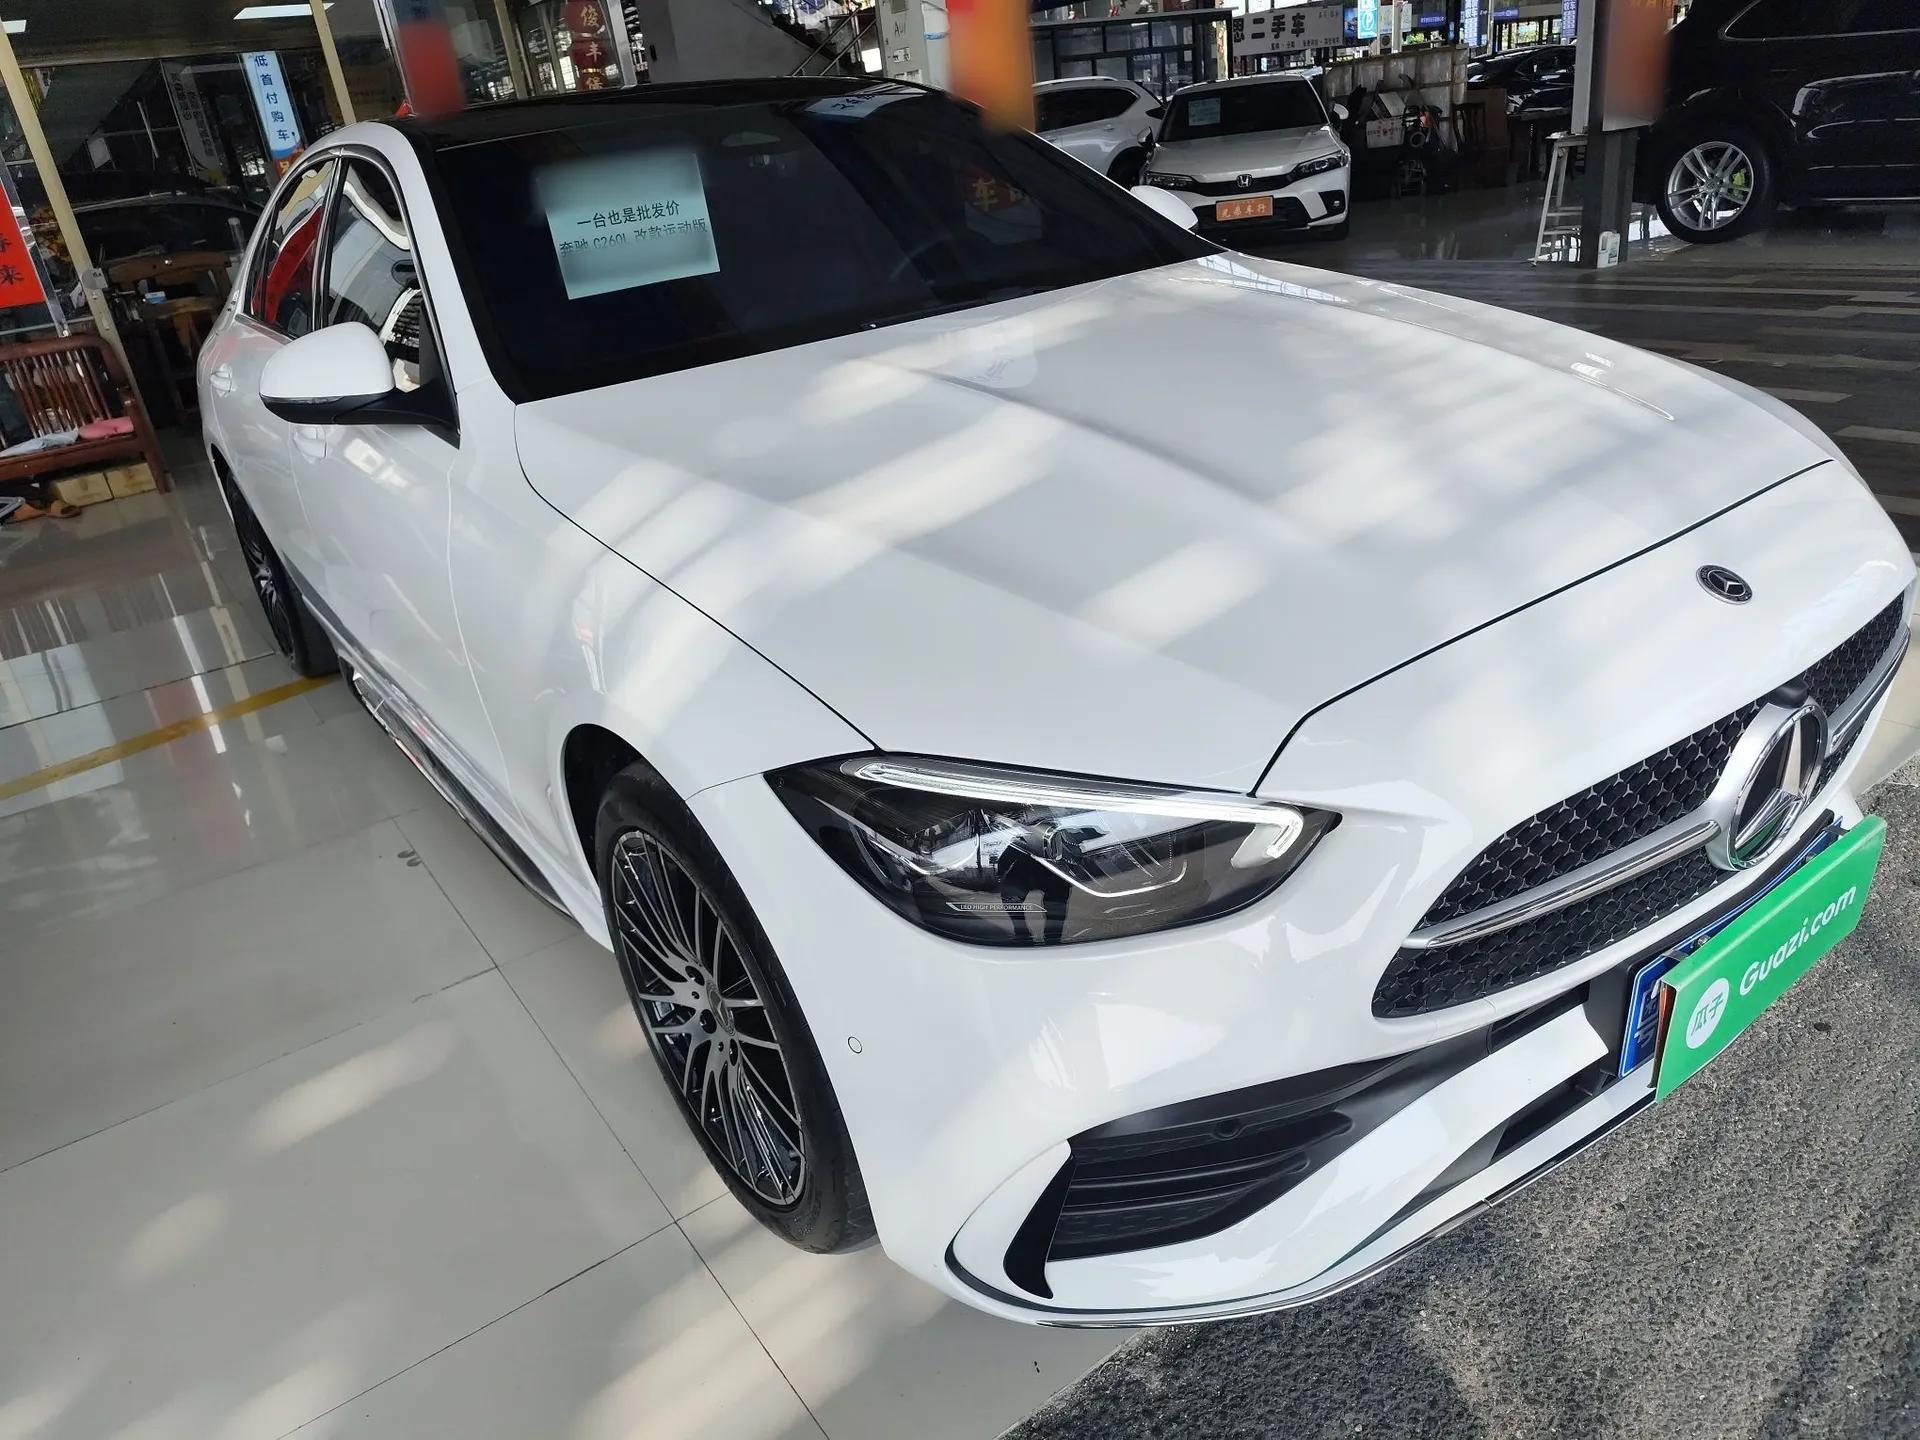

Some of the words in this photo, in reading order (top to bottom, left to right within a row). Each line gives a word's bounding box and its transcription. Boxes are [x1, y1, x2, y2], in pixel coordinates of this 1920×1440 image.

[255, 54, 290, 141] 低首付购车
[576, 200, 680, 229] 一台也是批发价
[1739, 886, 1857, 996] Guazi.com
[1691, 993, 1725, 1036] 瓜子
